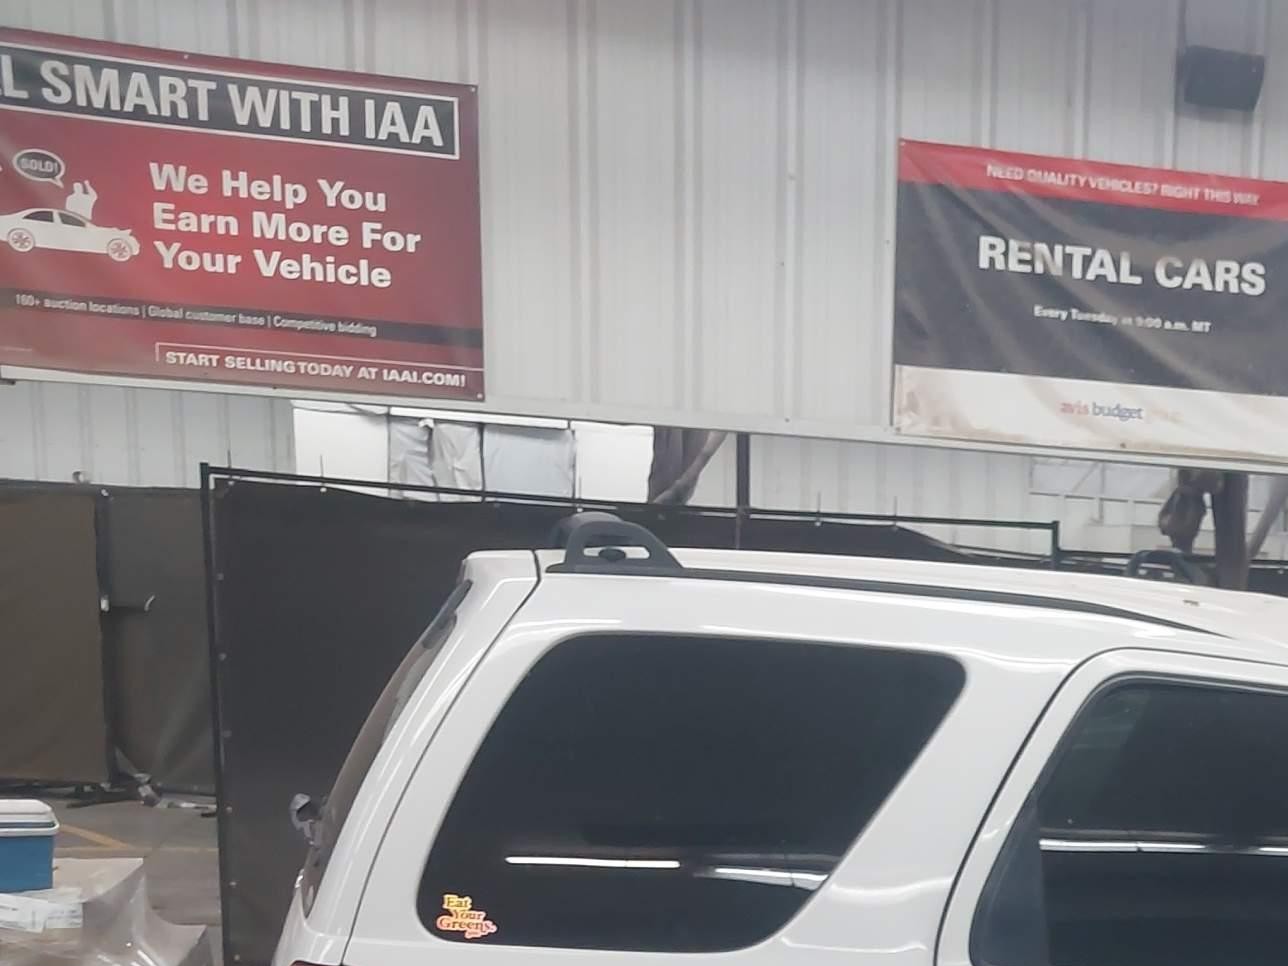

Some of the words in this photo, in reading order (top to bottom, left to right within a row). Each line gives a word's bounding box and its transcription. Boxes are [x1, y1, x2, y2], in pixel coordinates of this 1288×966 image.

[40, 60, 217, 121] SMART
[227, 83, 349, 136] WITH
[365, 99, 443, 146] IAA
[20, 158, 58, 173] SOLD!
[986, 164, 1024, 180] NEED
[1026, 169, 1088, 188] QUALITY
[1089, 175, 1158, 195] VEHICLES?
[1160, 185, 1200, 200] RIGHT
[1203, 188, 1231, 203] THIS
[149, 162, 208, 194] We
[222, 170, 307, 209] Help
[317, 179, 387, 212] You
[153, 202, 239, 235] Earn
[252, 211, 349, 246] More
[361, 222, 421, 252] For
[153, 241, 241, 274] Your
[253, 249, 392, 288] Vehicle
[978, 235, 1143, 285] RENTAL
[1154, 255, 1266, 296] CARS
[44, 298, 87, 311] auction
[89, 301, 139, 316] locations
[148, 305, 183, 319] Global
[185, 311, 236, 323] customer
[238, 314, 265, 325] base
[273, 316, 335, 332] Competitive
[337, 322, 377, 337] bidding
[1034, 304, 1068, 321] Every
[1070, 308, 1119, 326] Tuesday
[166, 351, 219, 367] START
[224, 355, 296, 374] SELLING
[297, 361, 353, 378] TODAY
[357, 366, 377, 380] AT
[382, 368, 466, 387] IAAI.COM!
[1092, 402, 1143, 421] budget
